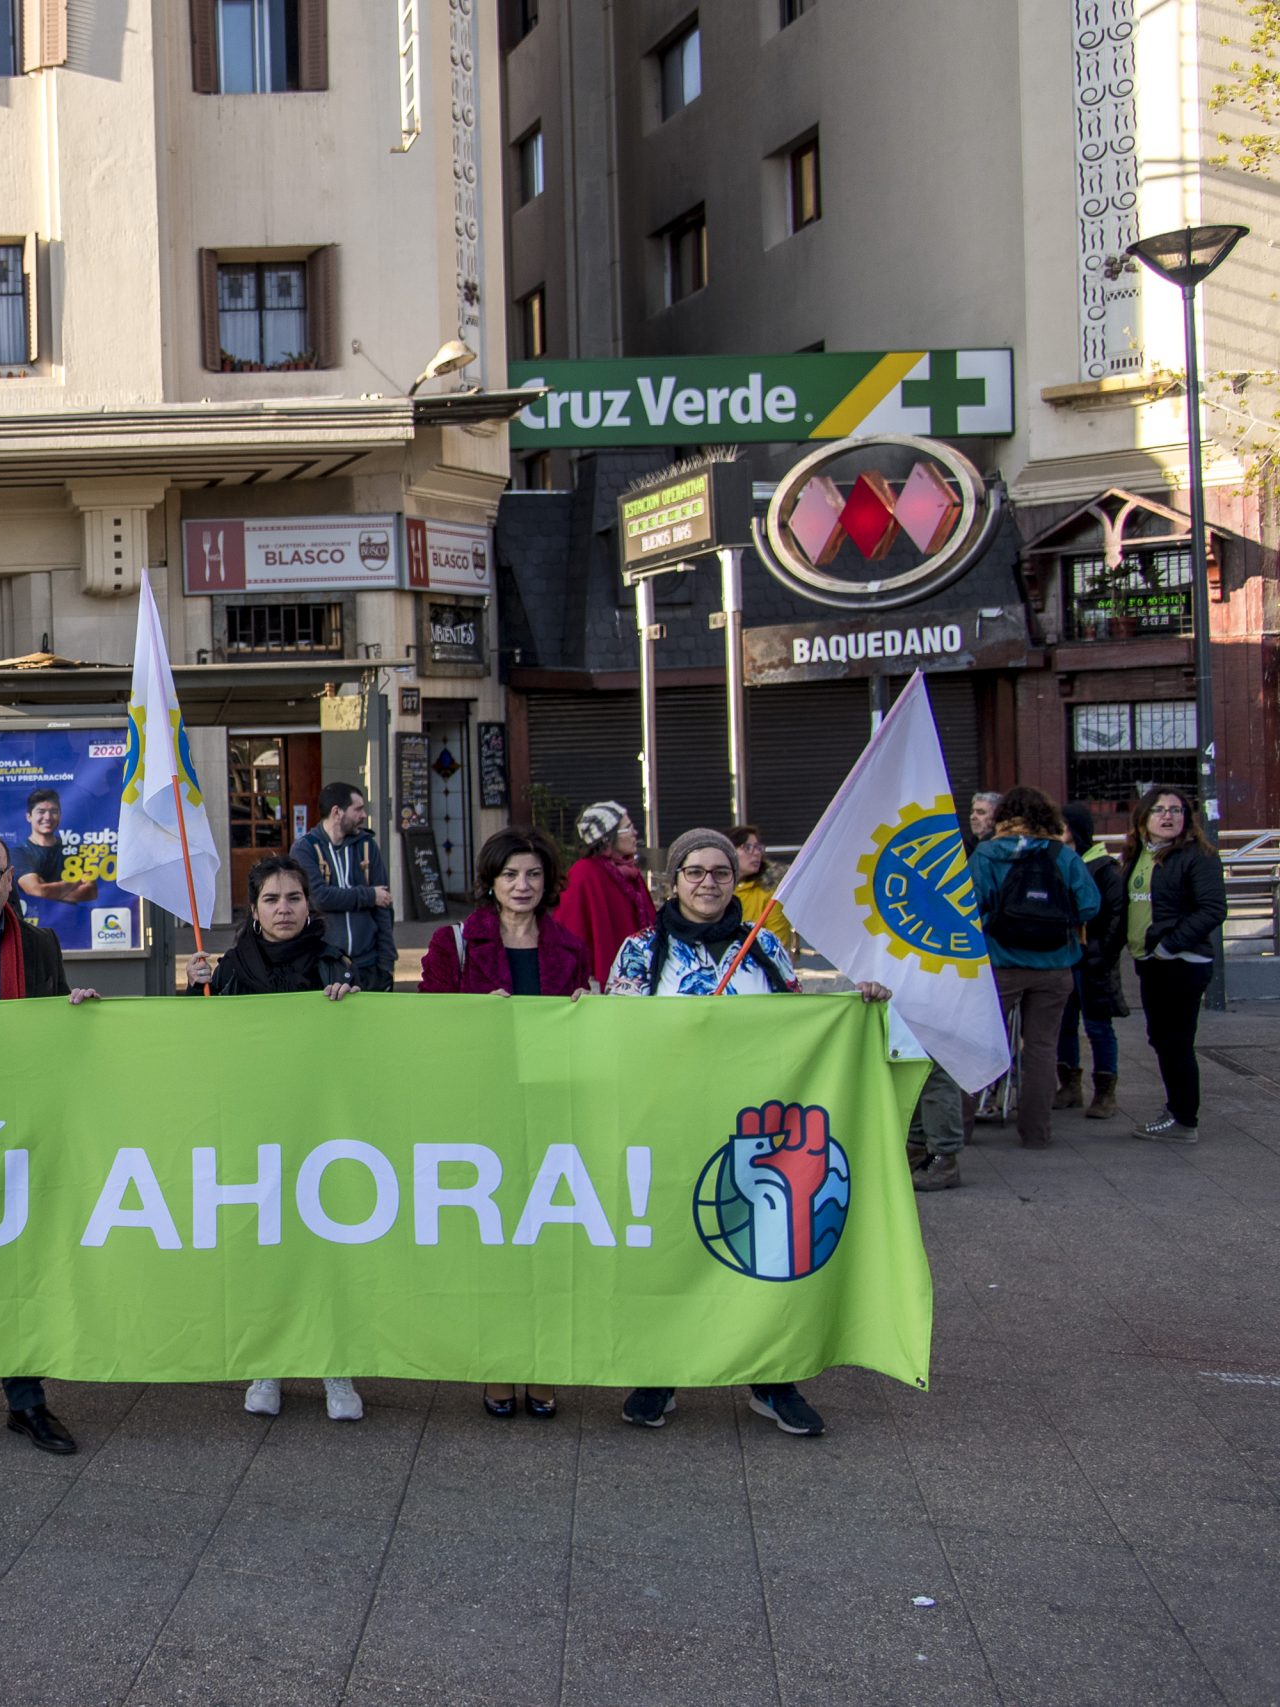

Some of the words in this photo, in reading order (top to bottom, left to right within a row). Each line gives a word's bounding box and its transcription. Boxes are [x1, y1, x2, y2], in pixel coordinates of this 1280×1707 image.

[519, 376, 632, 430] Cruz
[636, 372, 797, 426] Verde
[264, 549, 345, 567] BLASCO
[432, 552, 469, 570] BLASCO
[792, 624, 962, 664] BAQUEDANO
[93, 745, 123, 756] 2020
[1204, 741, 1216, 760] 4
[19, 759, 31, 767] LA
[18, 772, 74, 782] PREPARACIÓN
[58, 829, 81, 846] Yo
[82, 827, 119, 845] sub
[62, 845, 78, 856] de
[78, 843, 110, 858] 509
[61, 854, 118, 884] 850
[890, 828, 983, 934] AND
[885, 872, 972, 952] CHILE
[97, 931, 127, 940] Cpech
[79, 1139, 653, 1250] AHORA!
